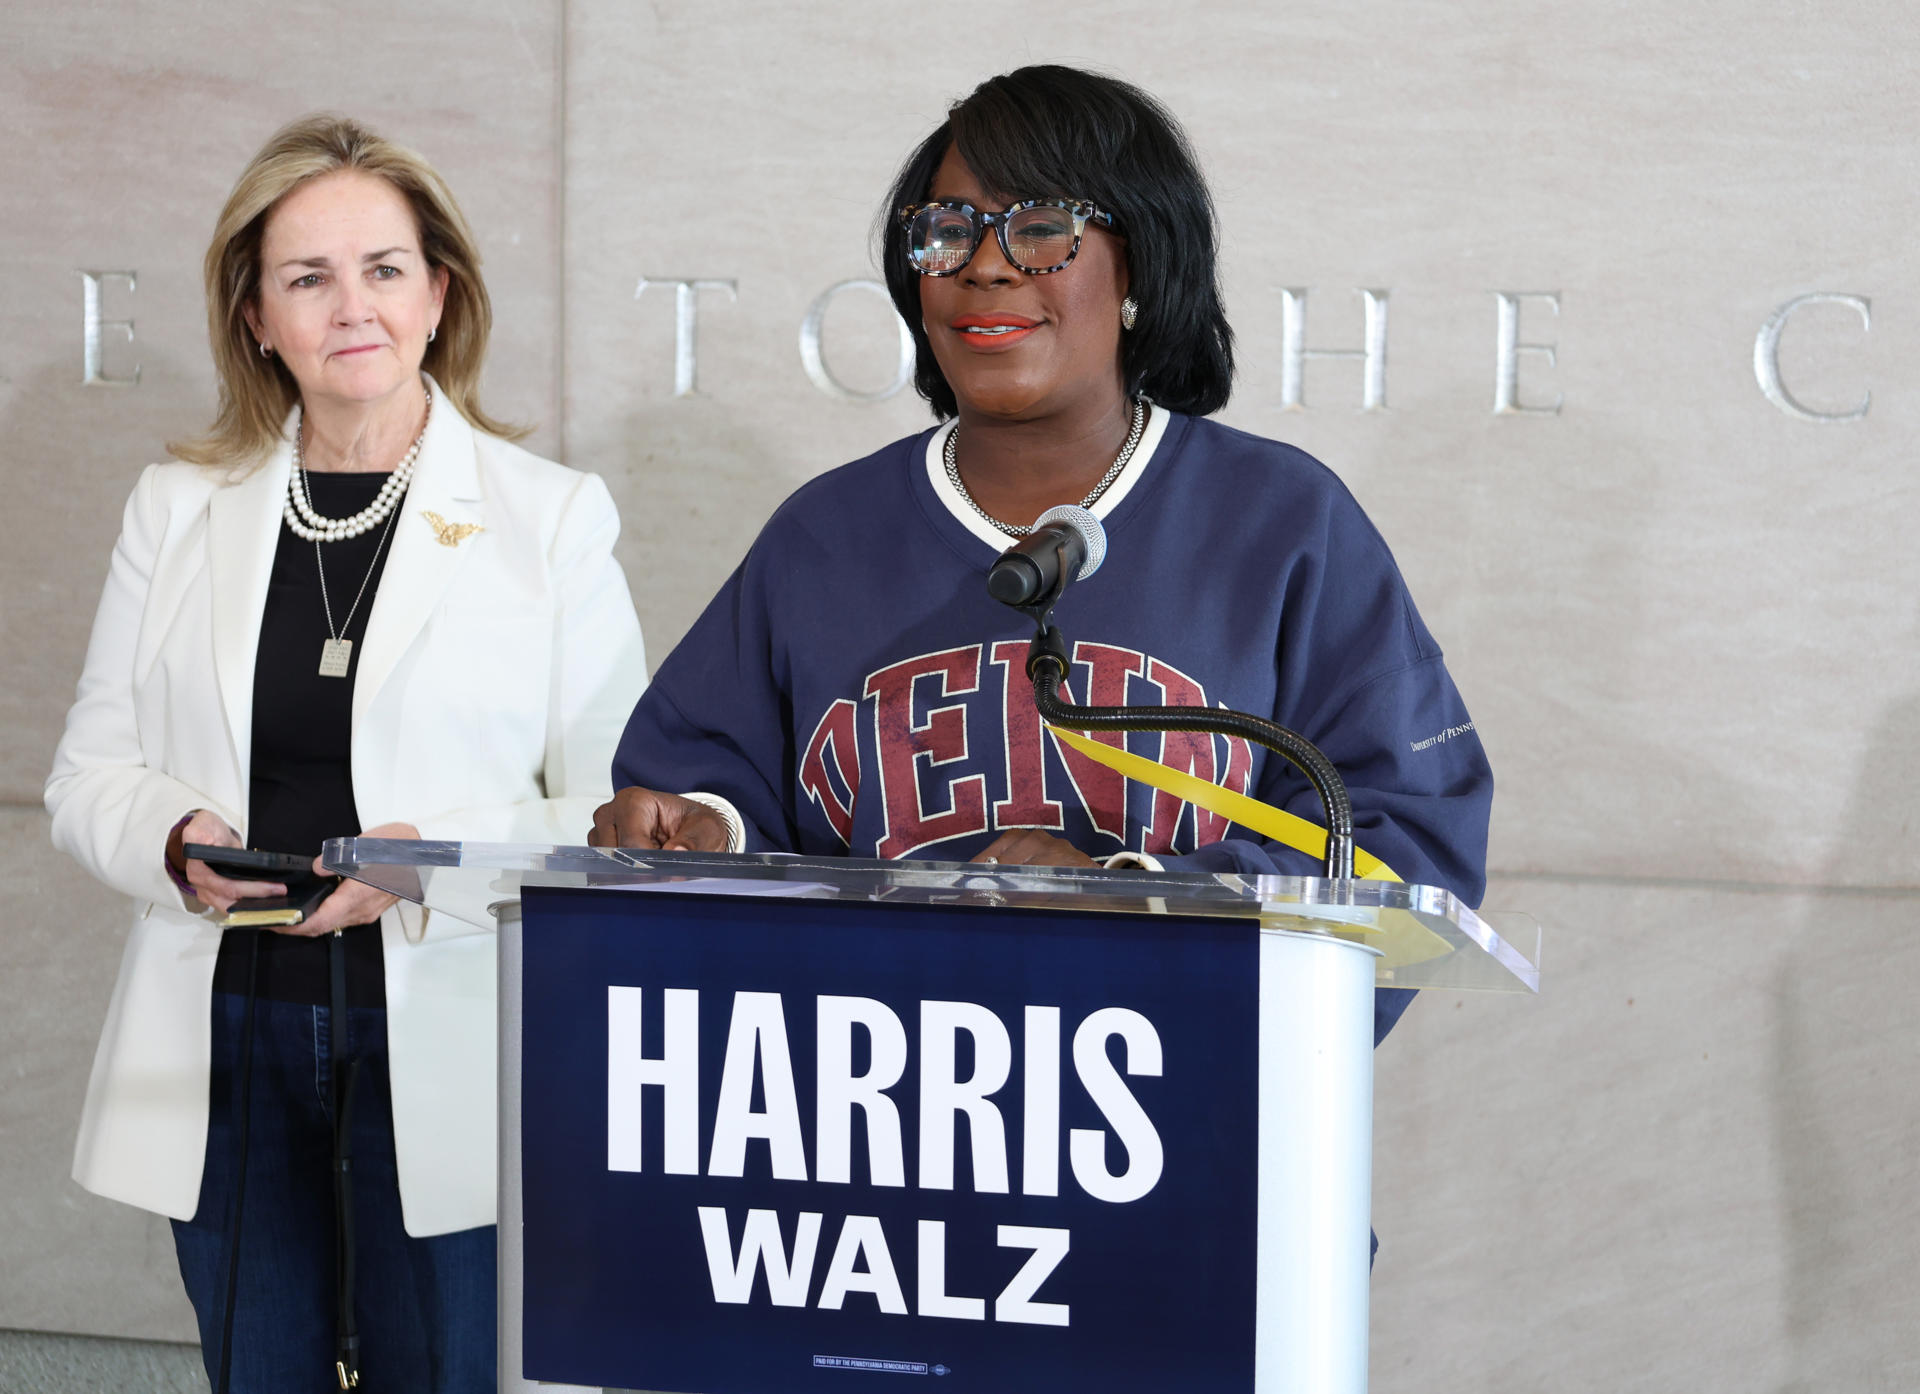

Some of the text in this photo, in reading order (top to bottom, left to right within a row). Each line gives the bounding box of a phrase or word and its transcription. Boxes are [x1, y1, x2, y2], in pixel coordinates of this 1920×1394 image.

[72, 268, 141, 388] E
[634, 277, 916, 401] TO
[1278, 285, 1564, 416] HE
[1437, 729, 1446, 744] of
[607, 985, 1164, 1203] HARRIS
[697, 1206, 1070, 1327] WALZ
[815, 1357, 925, 1372] PAID FOR BY THE PENNSYLVANIA DEMOCRATIC PARTY
